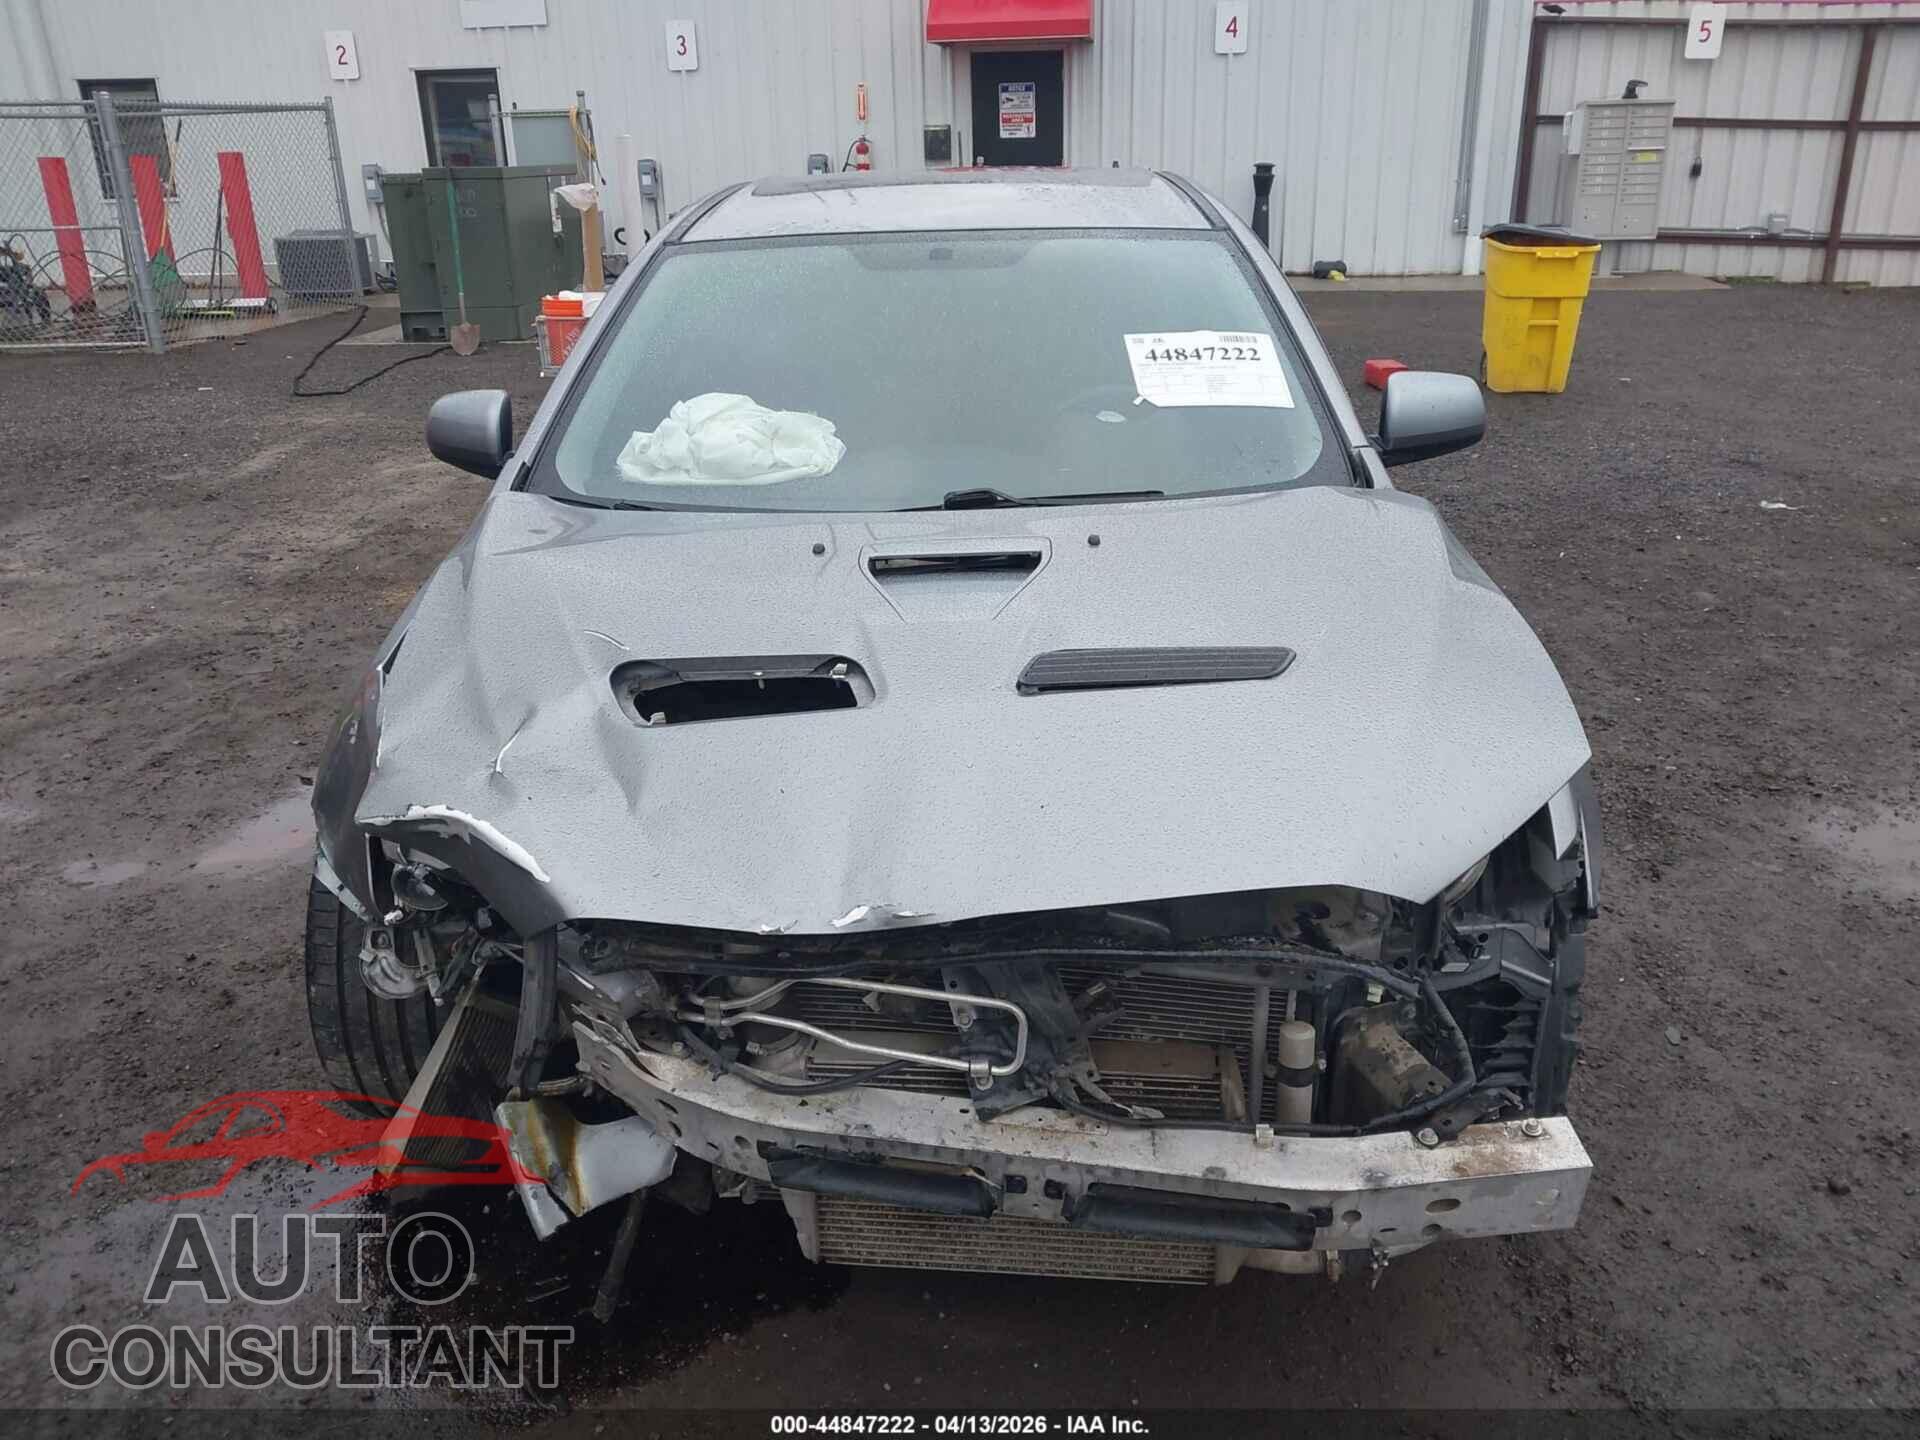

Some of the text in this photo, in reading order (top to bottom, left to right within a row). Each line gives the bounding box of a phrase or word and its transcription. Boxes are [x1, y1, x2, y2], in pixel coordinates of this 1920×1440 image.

[1225, 15, 1238, 38] 4
[1698, 20, 1713, 43] 5
[335, 45, 348, 65] 2
[676, 34, 688, 56] 3
[1144, 346, 1261, 362] 44847222
